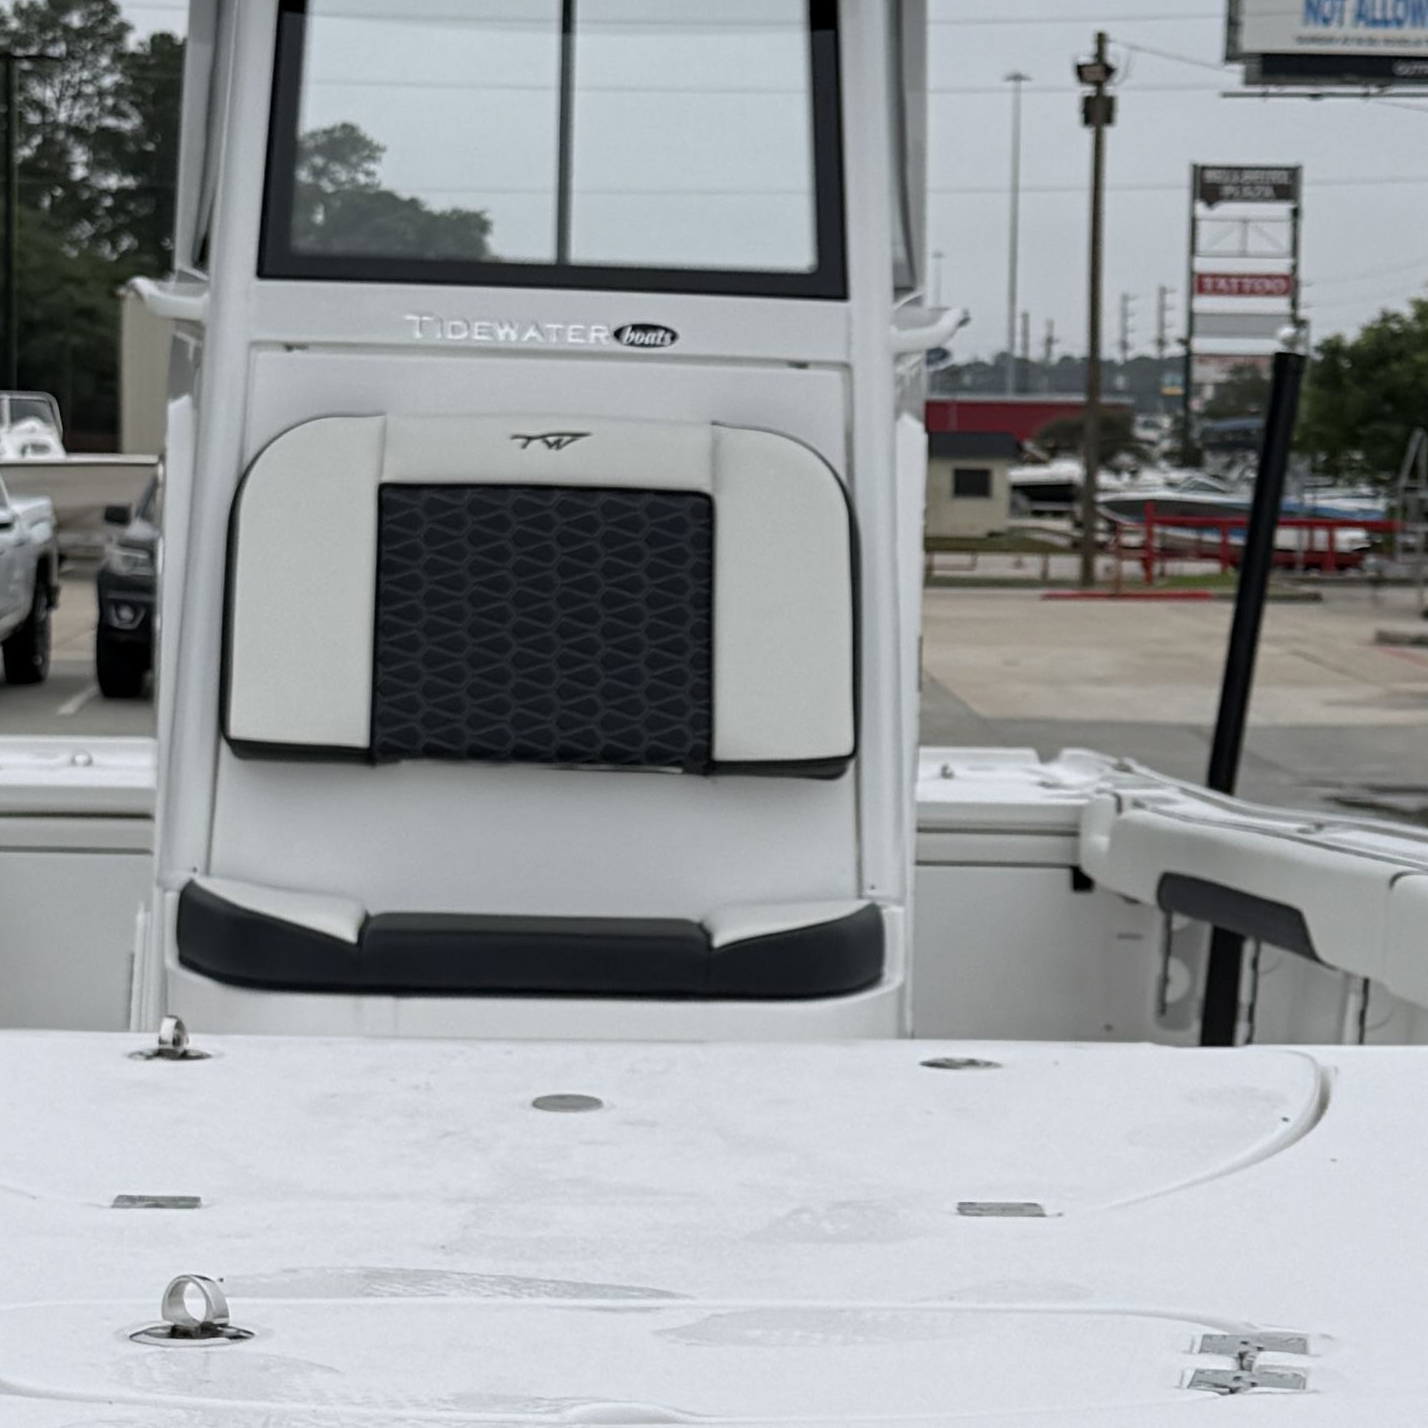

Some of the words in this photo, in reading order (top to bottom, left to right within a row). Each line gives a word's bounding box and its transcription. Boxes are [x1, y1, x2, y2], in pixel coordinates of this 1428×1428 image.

[1201, 276, 1288, 294] TATTOO
[403, 313, 611, 347] TIDEWATER
[622, 325, 675, 348] boats
